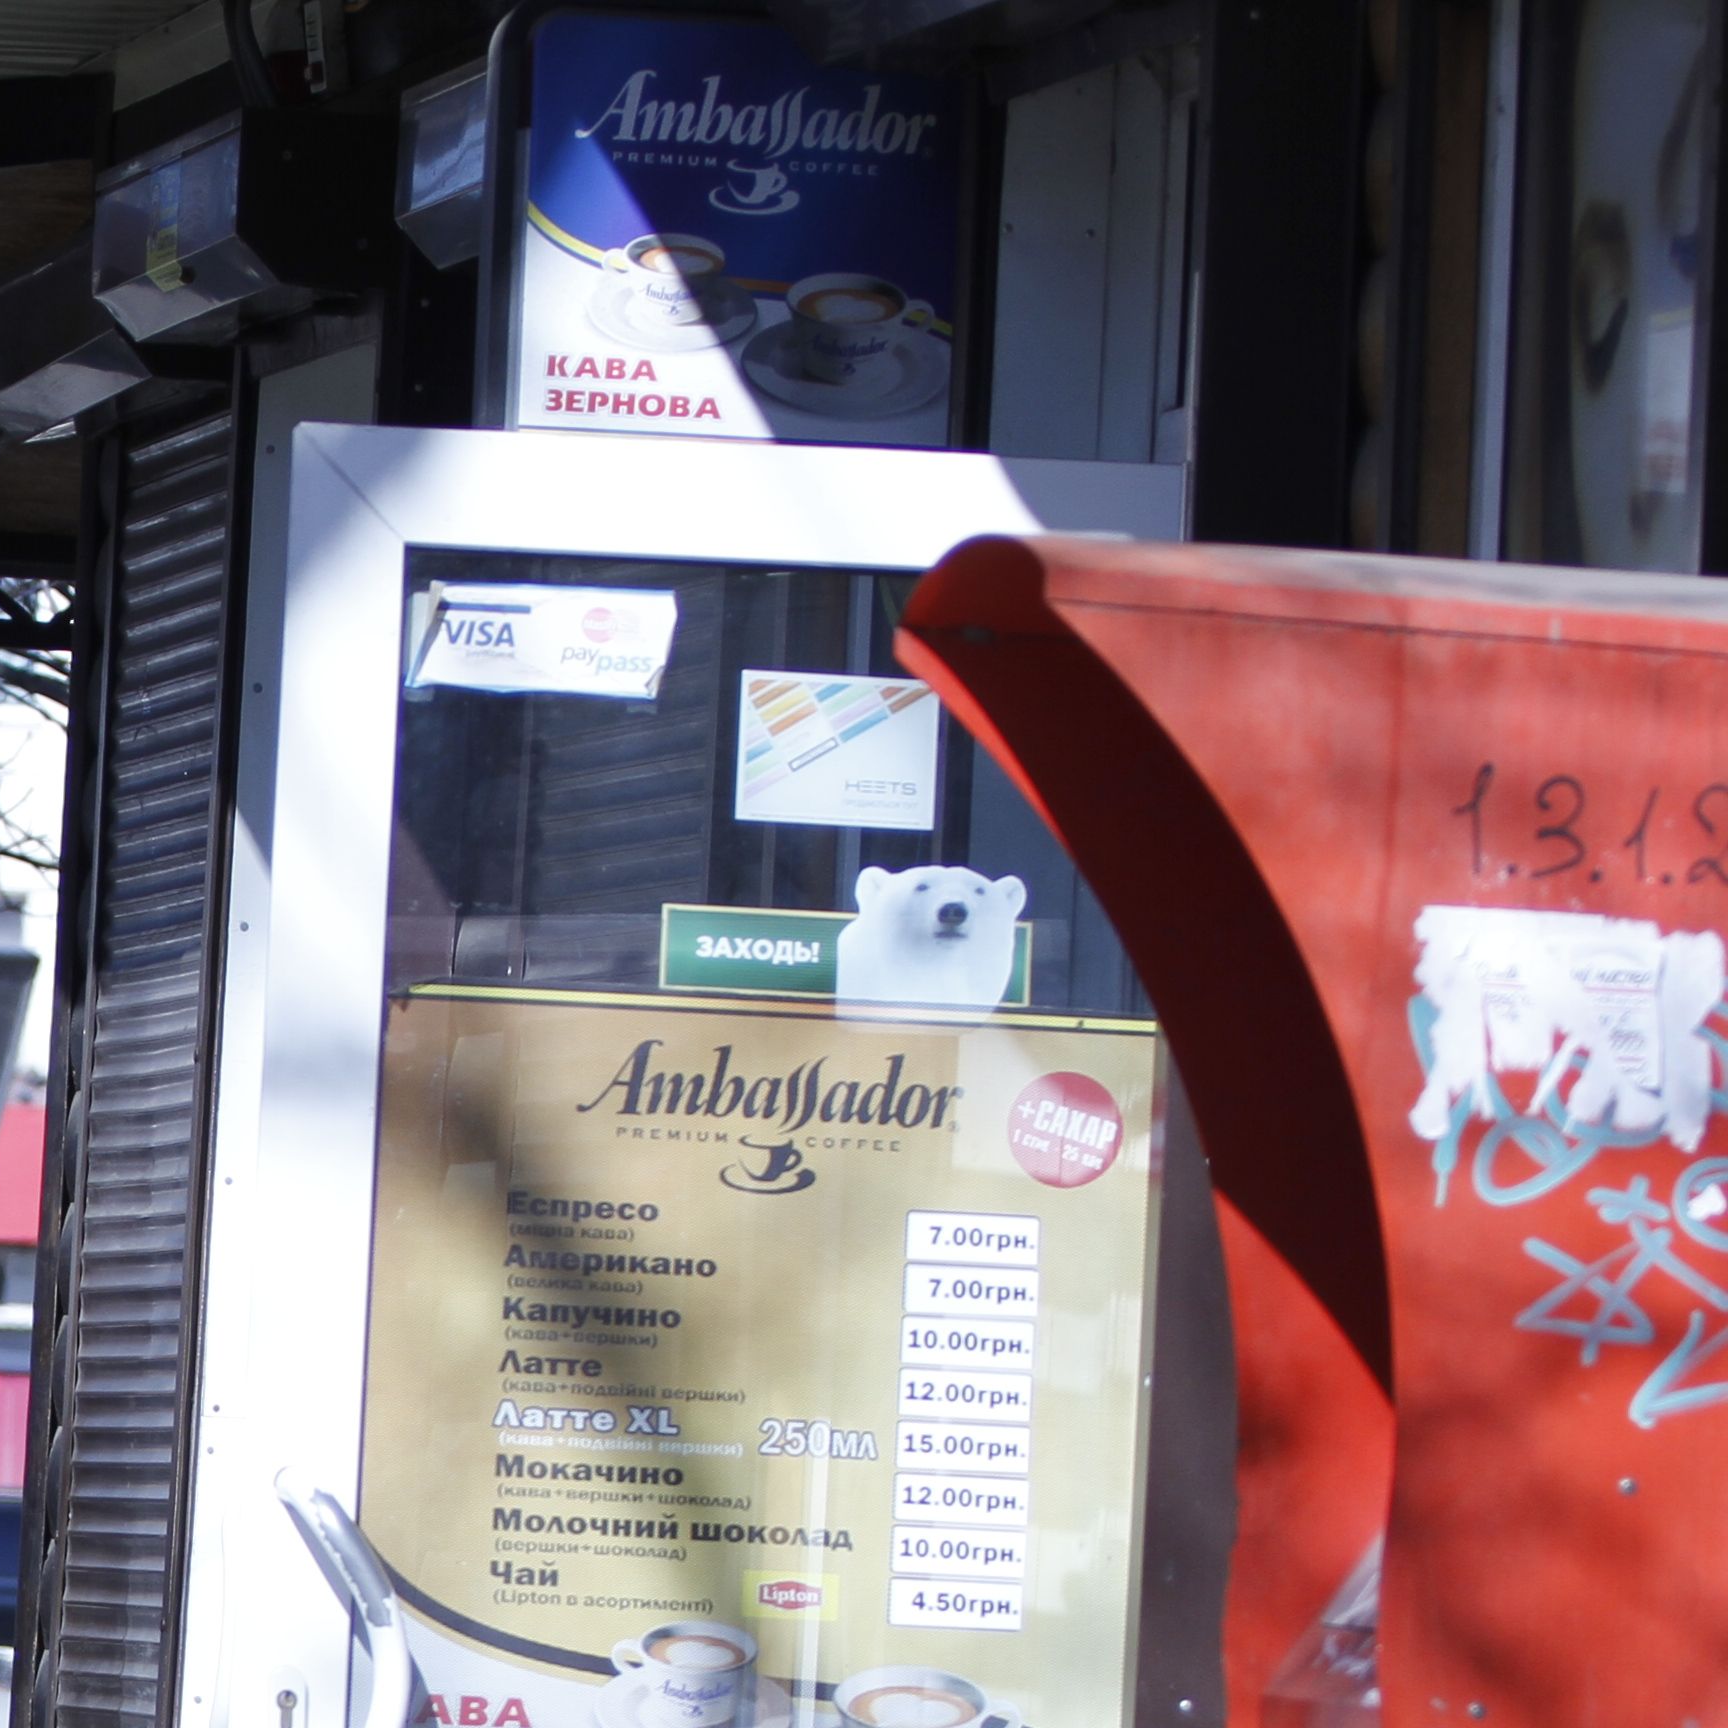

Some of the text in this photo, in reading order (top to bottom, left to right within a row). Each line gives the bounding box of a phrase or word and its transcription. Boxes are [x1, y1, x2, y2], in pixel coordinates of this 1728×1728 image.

[575, 70, 937, 158] Ambassador
[612, 151, 879, 176] PREMIUM COFFEE
[546, 354, 658, 382] КАВА
[545, 389, 721, 420] ЗЕРНОВА
[444, 619, 516, 648] VISA
[845, 779, 918, 796] HEETS
[695, 935, 821, 965] ЗАХОДЬ!
[576, 1039, 964, 1134] Ambassador
[616, 1127, 902, 1153] PREMIUM COFFEE
[506, 1192, 660, 1222] Еспресо
[929, 1226, 1036, 1252] 7.00грн.
[504, 1243, 717, 1278] Американо
[928, 1278, 1035, 1305] 7.00грн.
[502, 1296, 681, 1329] Капучино
[908, 1329, 1030, 1357] 10.00грн.
[498, 1350, 603, 1378] Латте
[905, 1381, 1028, 1409] 12.00грн.
[493, 1398, 681, 1436] Латте XL
[904, 1433, 1027, 1461] 15.00грн.
[495, 1453, 684, 1487] Мокачино
[902, 1485, 1025, 1512] 12.00грн.
[492, 1506, 854, 1552] Молочний шоколад
[899, 1537, 1022, 1565] 10.00грн.
[489, 1560, 559, 1587] Чай
[761, 1585, 819, 1605] Lipton
[911, 1590, 1019, 1618] 4.50грн.
